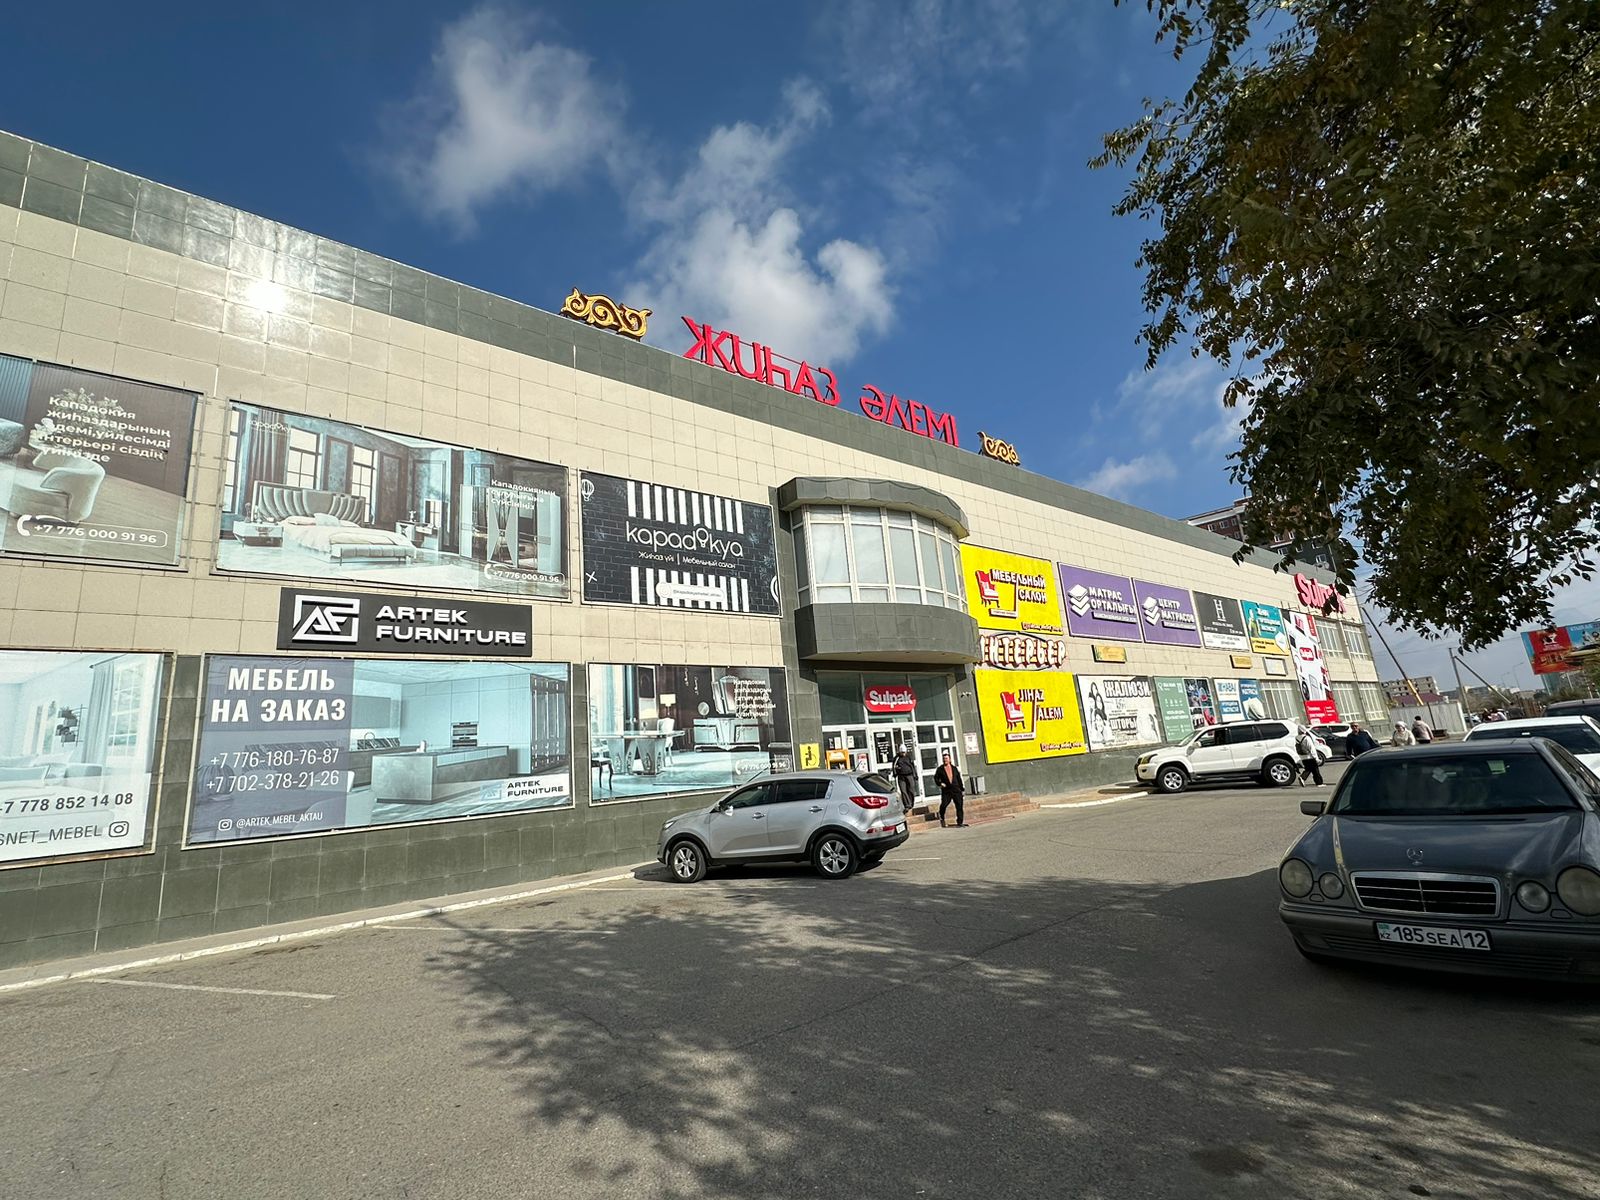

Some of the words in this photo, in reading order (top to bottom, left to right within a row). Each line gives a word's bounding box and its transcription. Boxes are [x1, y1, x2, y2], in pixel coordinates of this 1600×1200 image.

[49, 396, 136, 420] Кападокия
[859, 384, 959, 447] ӘЛЕМІ
[37, 433, 115, 452] нтерьері
[34, 524, 54, 534] +7
[56, 525, 85, 536] 776
[88, 529, 117, 540] 000
[121, 532, 136, 542] 91
[138, 534, 157, 544] 96
[504, 571, 520, 580] 776
[522, 573, 538, 581] 000
[991, 569, 1046, 589] МЕБЕЛЬНЫЙ
[1018, 589, 1048, 604] САЛОН
[1088, 587, 1123, 602] МАТРАС
[1294, 573, 1346, 614] Sulp
[1158, 598, 1180, 610] ЦЕНТР
[375, 605, 468, 624] ARTEK
[376, 625, 527, 645] FURNITURE
[228, 668, 335, 691] МЕБЕЛЬ
[1103, 680, 1152, 698] ЖАЛЮЗИ
[869, 690, 913, 709] Sulpak
[211, 699, 249, 722] НА
[260, 698, 346, 722] ЗАКАЗ
[1109, 717, 1138, 731] ШТОРЫ
[210, 753, 228, 769] +7
[233, 748, 339, 768] 776-180-76-87
[206, 776, 224, 793] +7
[229, 770, 339, 792] 702-378-21-26
[507, 780, 541, 789] ARTEK
[507, 786, 564, 798] FURNITURE
[20, 799, 49, 813] 778
[55, 796, 86, 810] 852
[91, 795, 110, 807] 14
[114, 793, 133, 805] 08
[1392, 926, 1425, 943] 185
[1426, 932, 1461, 947] SEA
[1463, 932, 1489, 949] 12
